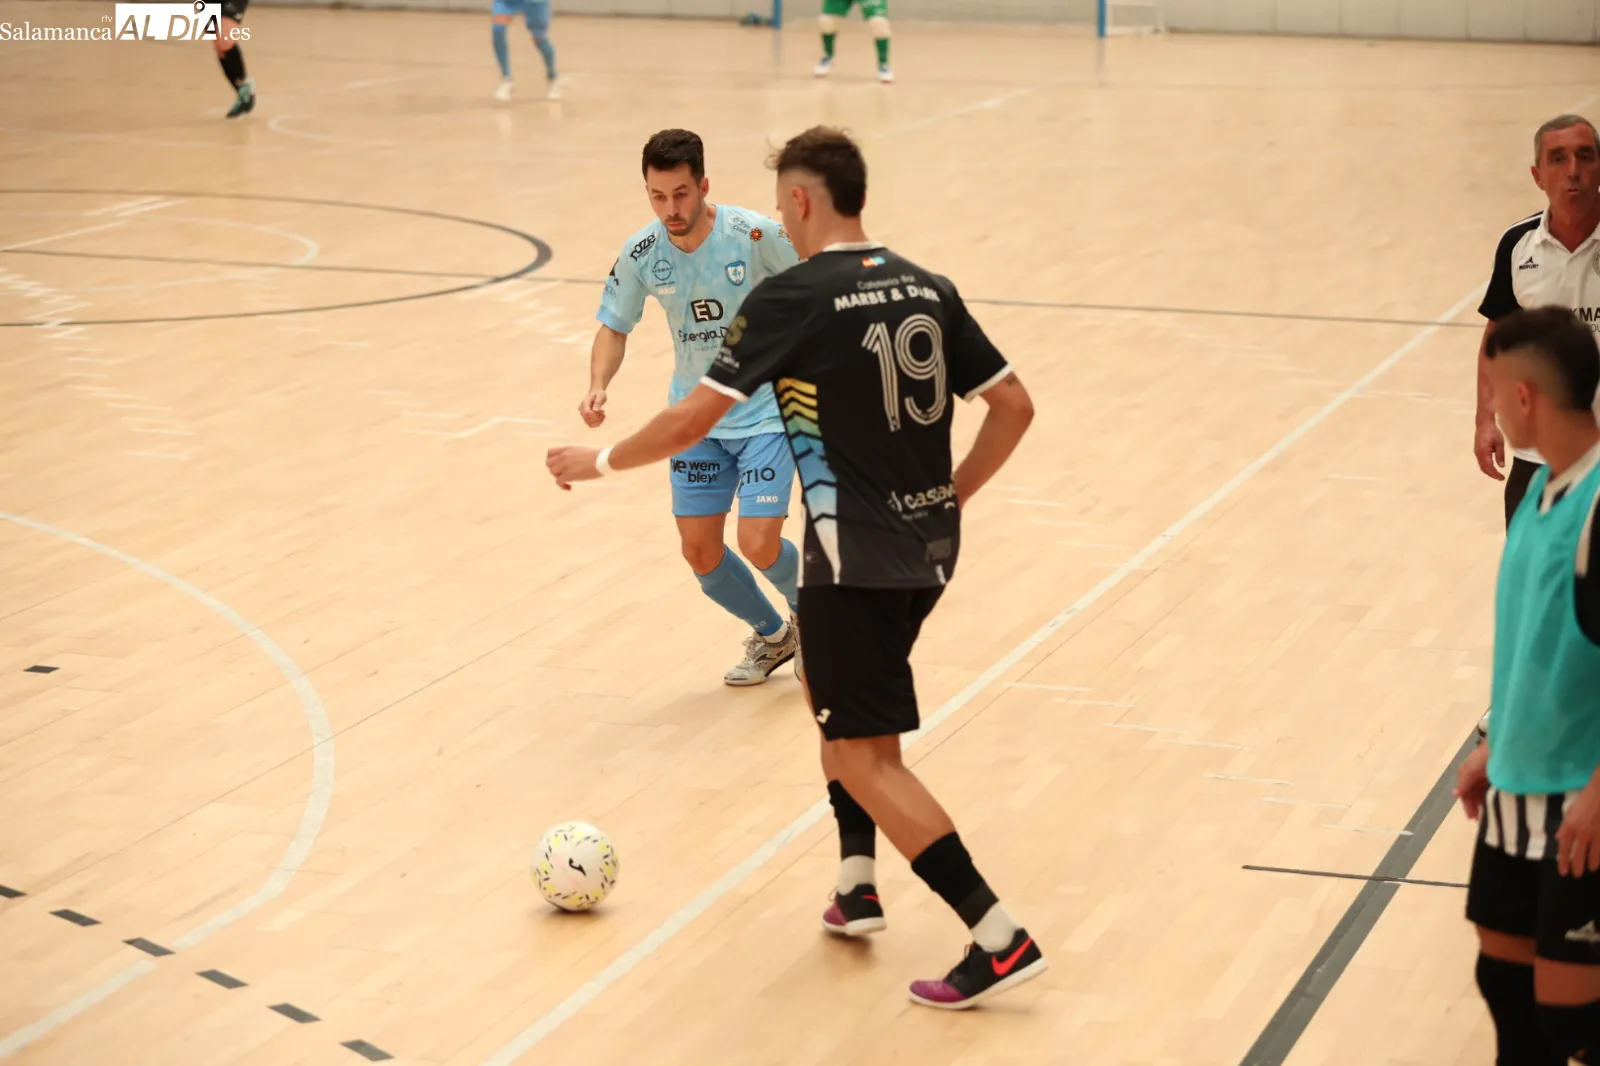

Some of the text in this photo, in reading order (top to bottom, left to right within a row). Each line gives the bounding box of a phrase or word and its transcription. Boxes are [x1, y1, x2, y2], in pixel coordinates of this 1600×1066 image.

[834, 290, 888, 312] MARBE
[890, 288, 905, 301] &
[861, 313, 947, 432] 19
